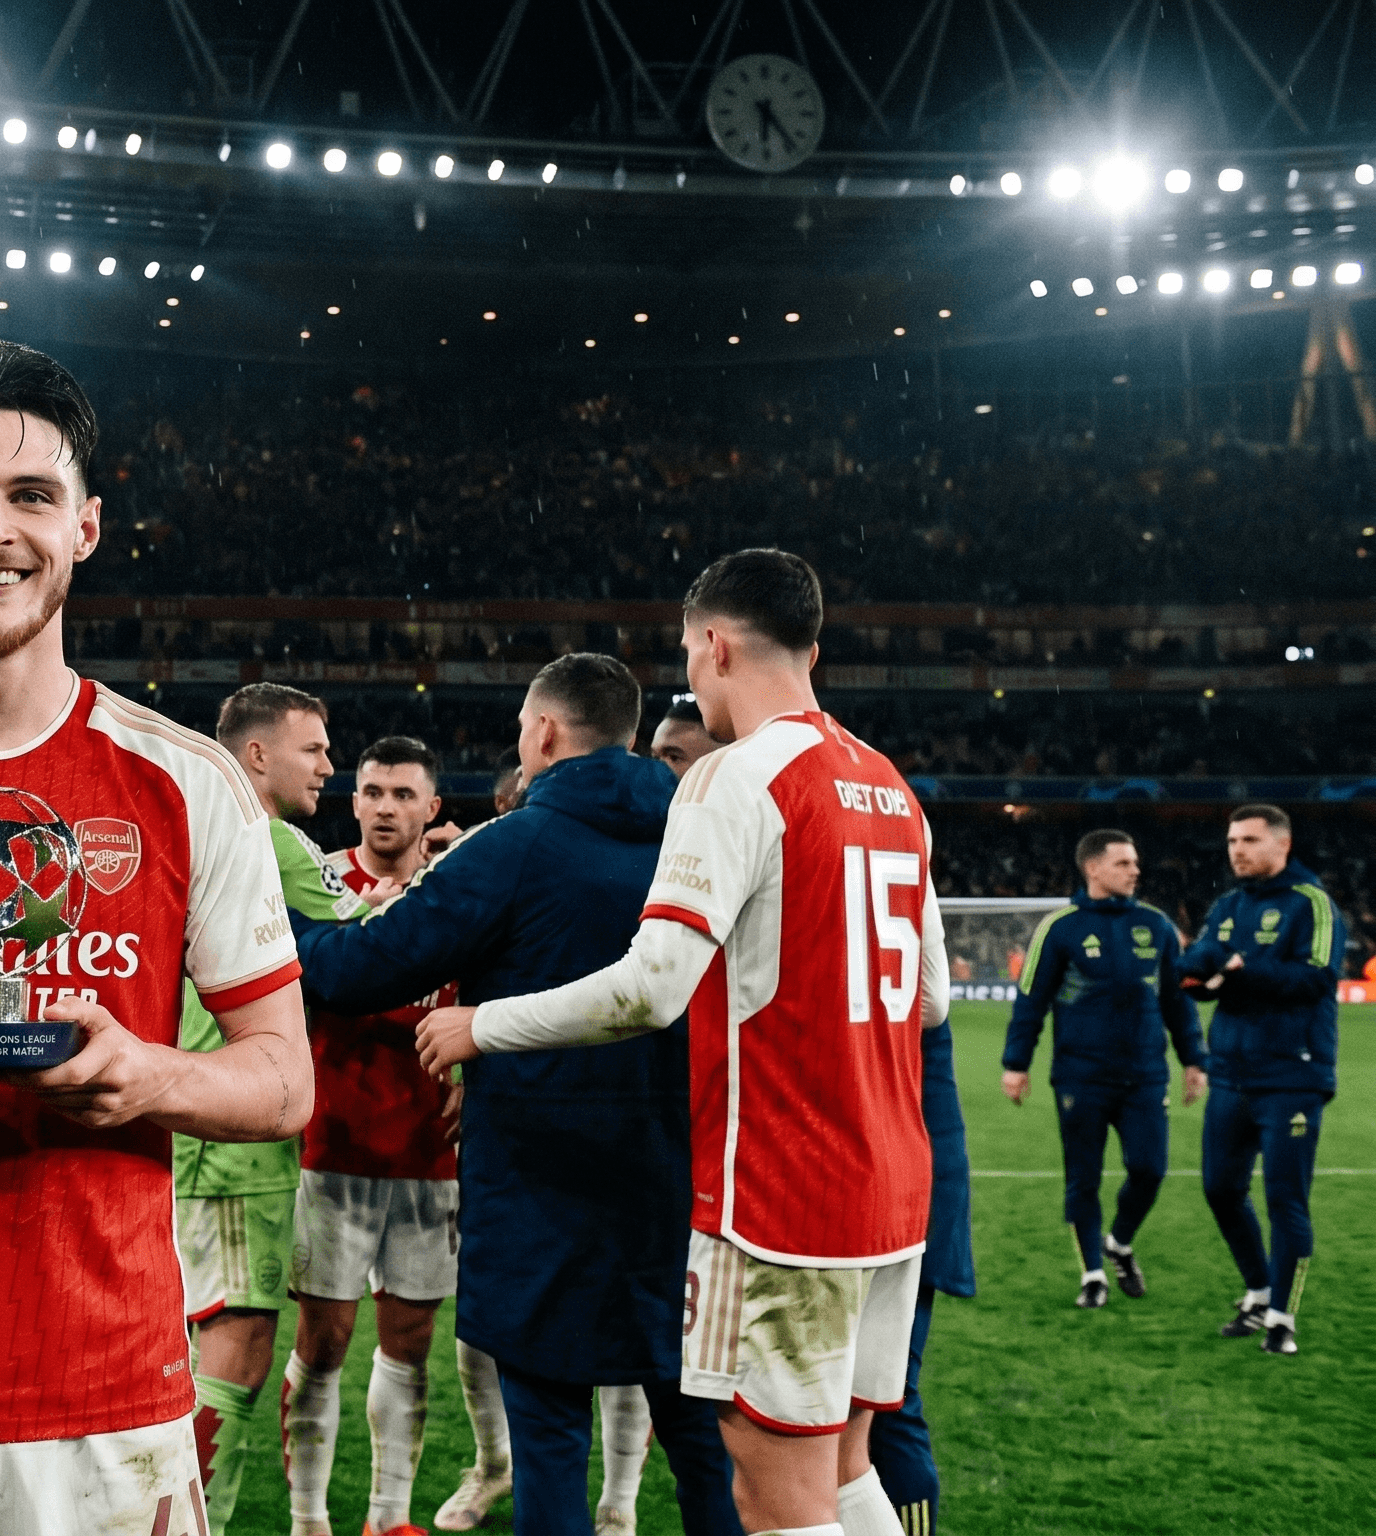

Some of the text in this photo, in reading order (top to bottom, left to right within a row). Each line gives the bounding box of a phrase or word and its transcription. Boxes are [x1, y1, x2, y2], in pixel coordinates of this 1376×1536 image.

[82, 830, 131, 845] Arsenal
[843, 845, 921, 1023] 15
[22, 1034, 56, 1044] LEAGUE
